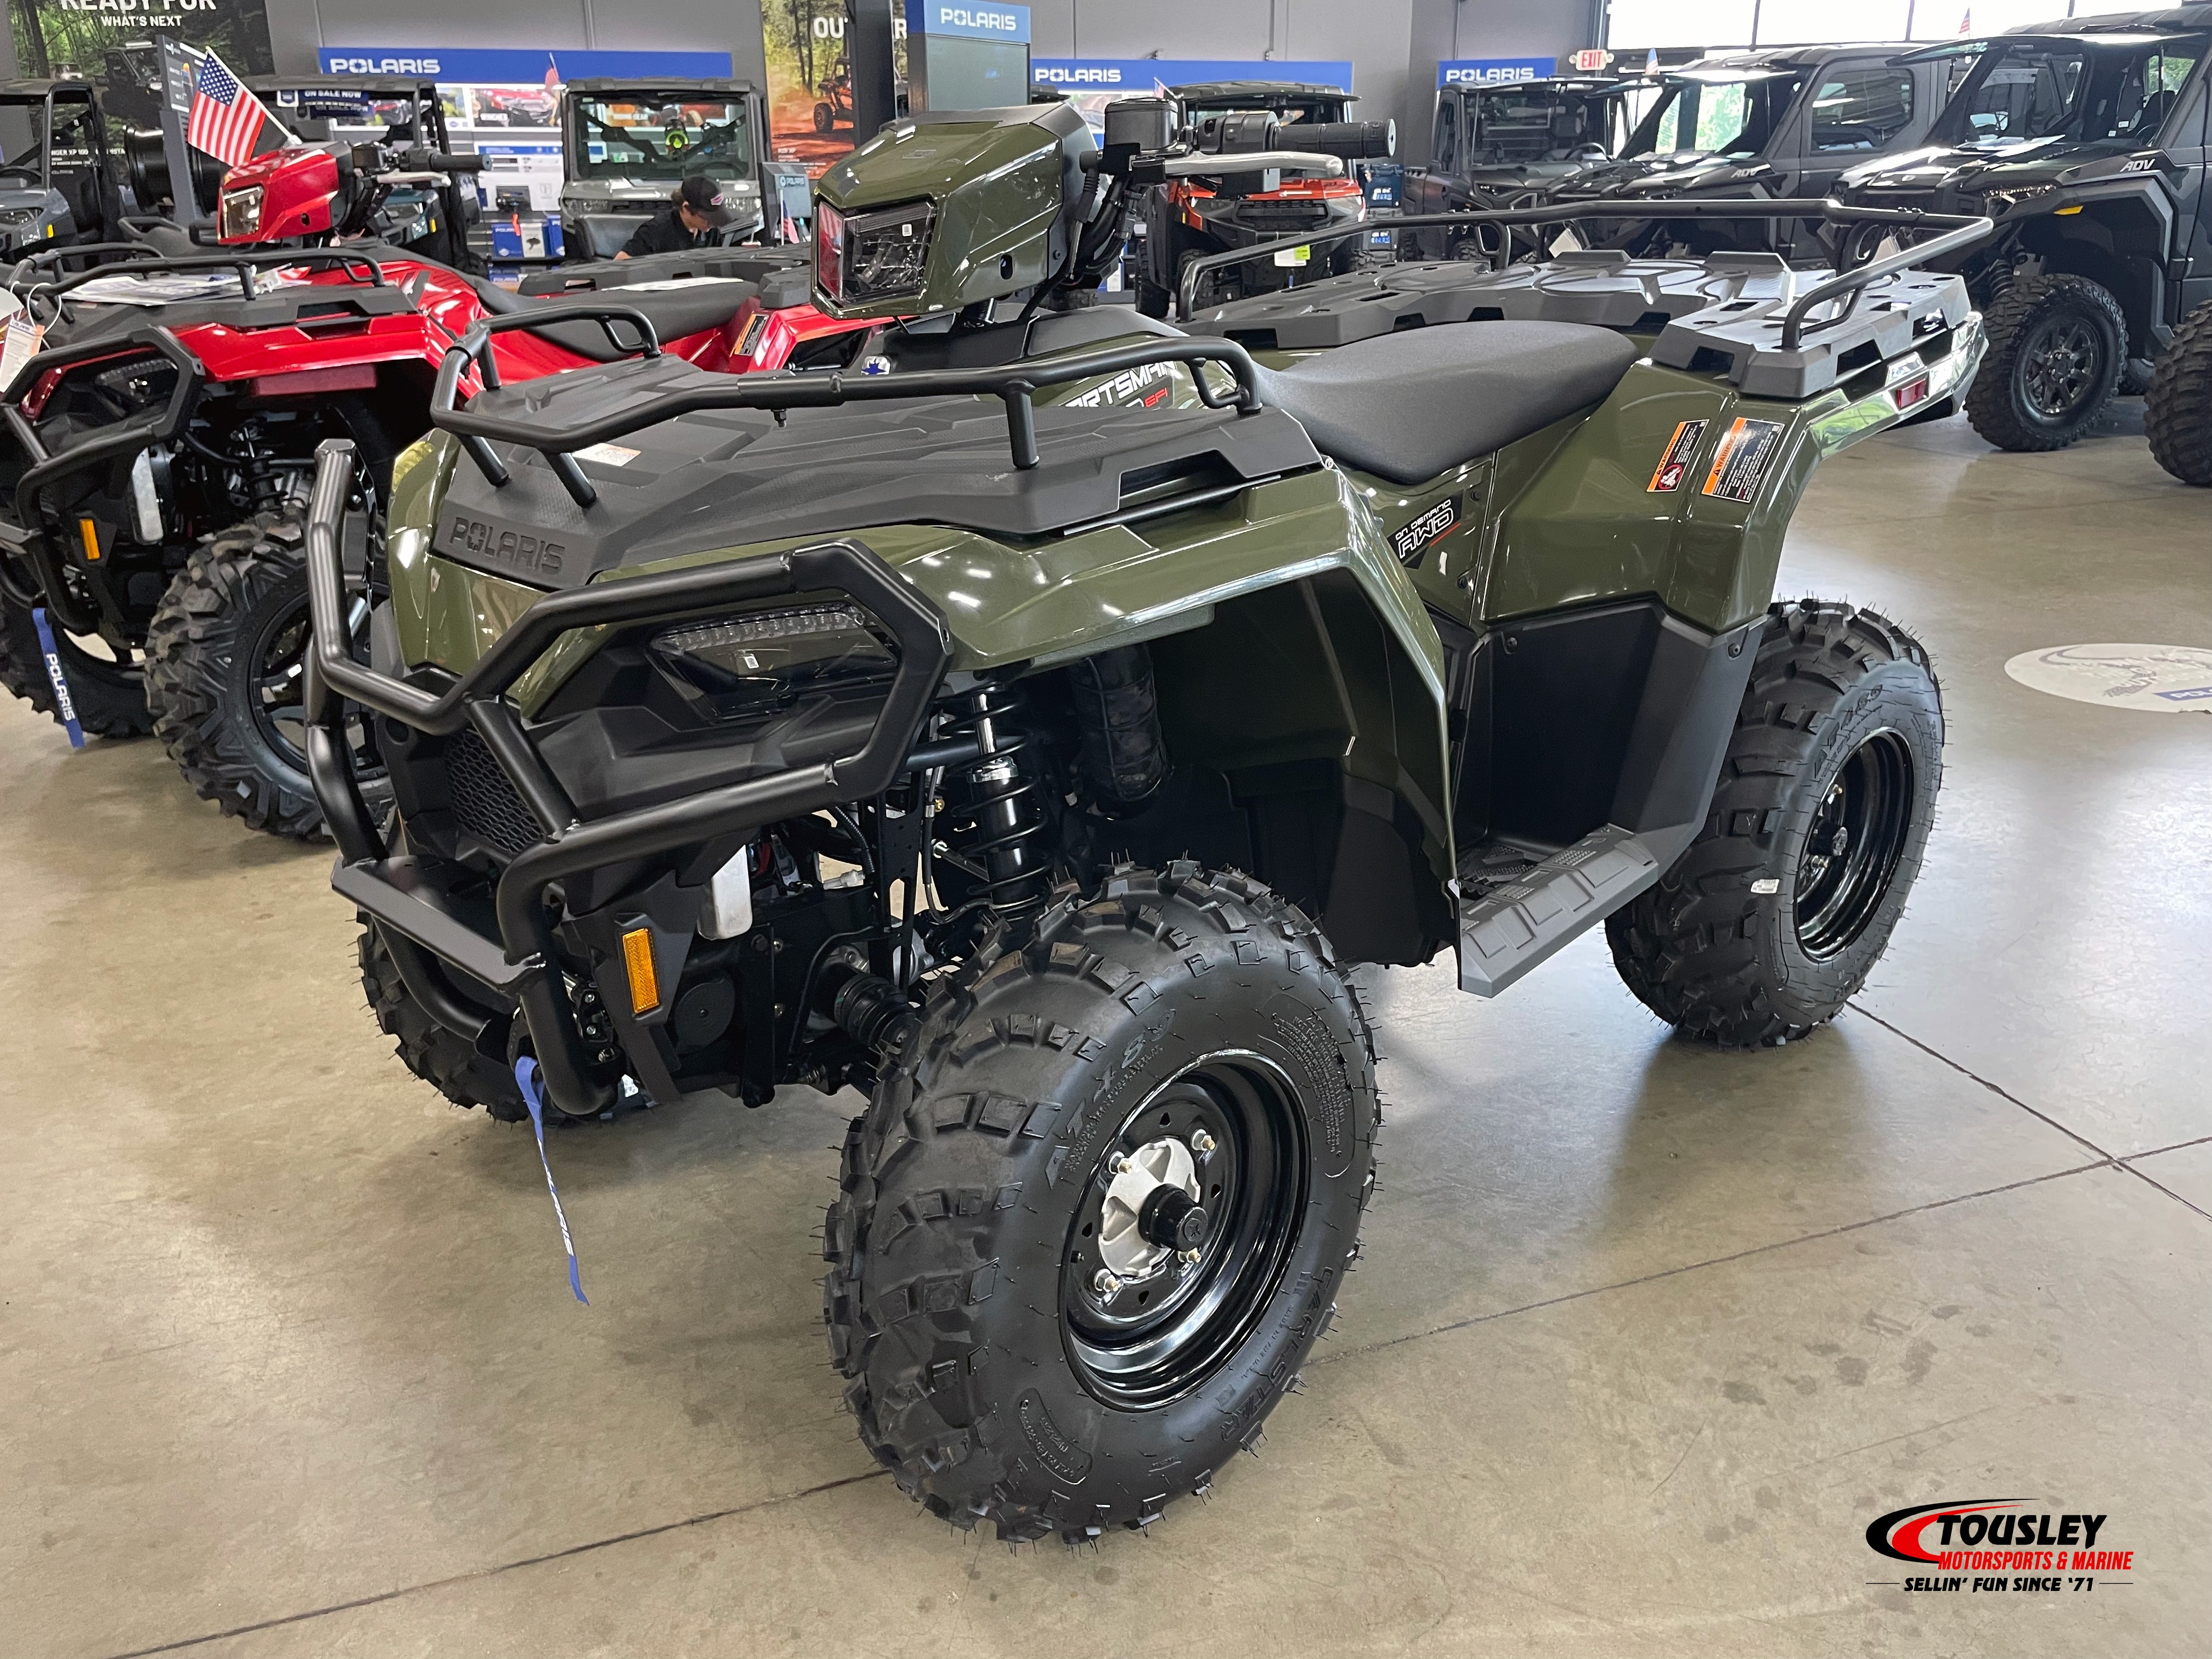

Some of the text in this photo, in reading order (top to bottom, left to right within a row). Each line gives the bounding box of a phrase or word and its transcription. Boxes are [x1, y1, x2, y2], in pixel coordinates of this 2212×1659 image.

[100, 15, 182, 27] WHAT'S NEXT
[940, 8, 1017, 31] POLARIS
[330, 58, 441, 74] POLARIS
[1581, 52, 1602, 68] EXIT
[1035, 67, 1122, 82] POLARIS
[1446, 67, 1534, 82] POLARIS
[2119, 159, 2155, 172] ADV
[1145, 387, 1167, 407] EFI
[1398, 507, 1454, 559] AWD
[449, 517, 566, 575] POLARIS
[46, 653, 76, 721] POLARIS
